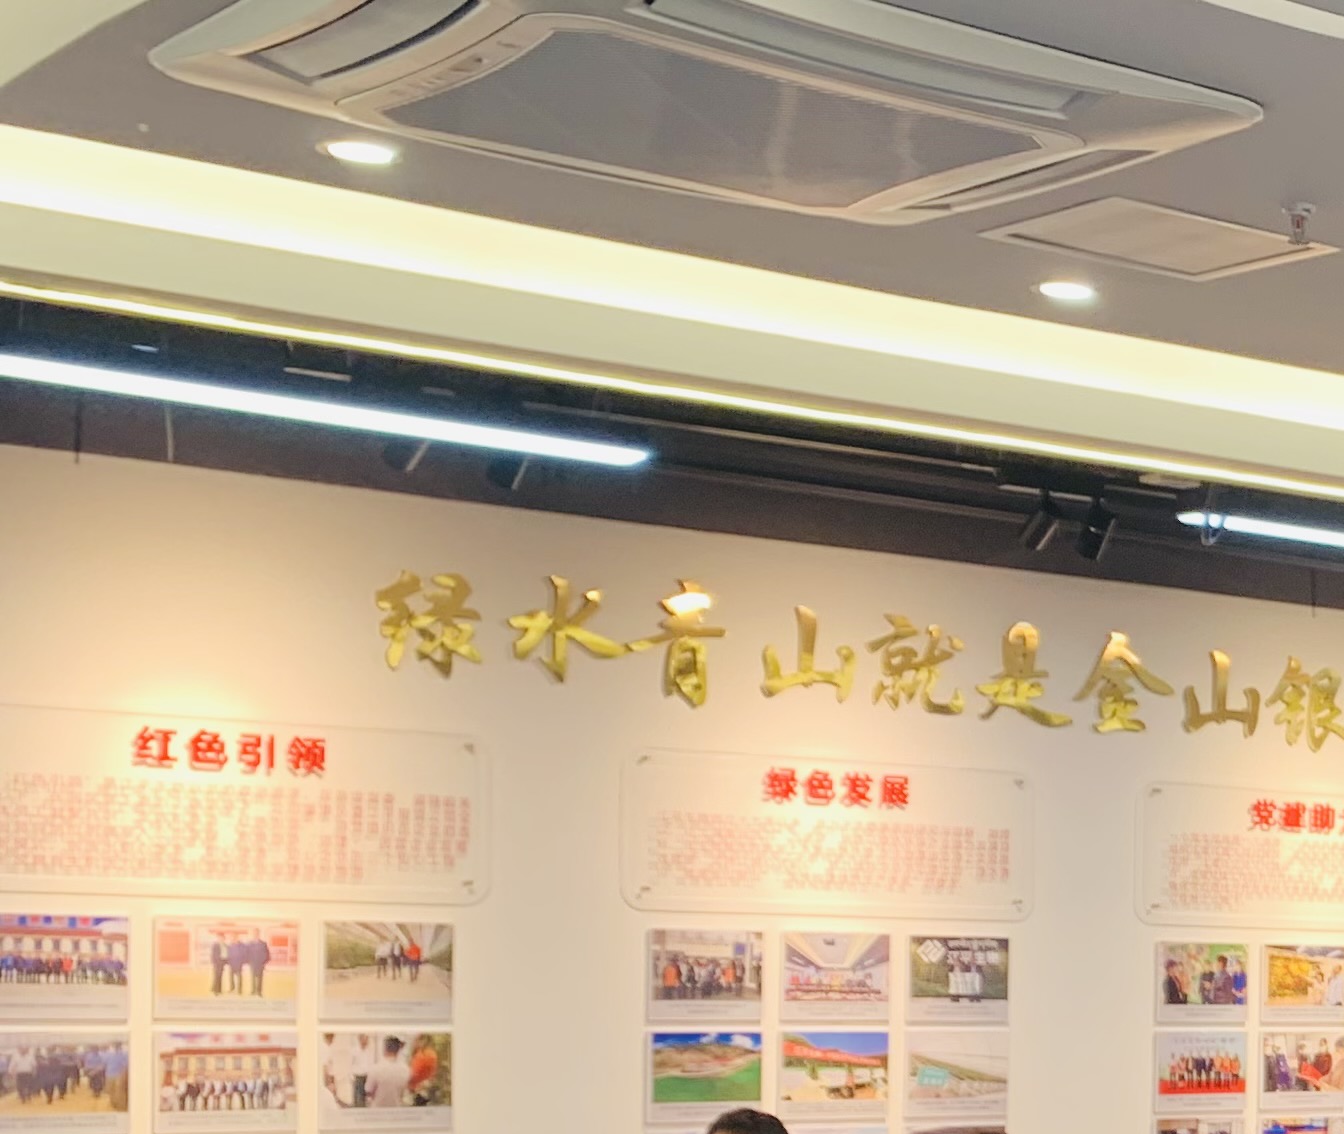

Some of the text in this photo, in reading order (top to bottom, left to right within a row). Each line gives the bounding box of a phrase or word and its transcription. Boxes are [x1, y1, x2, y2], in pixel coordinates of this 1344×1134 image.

[131, 726, 327, 778] 红色引领
[763, 767, 911, 809] 绿色发展
